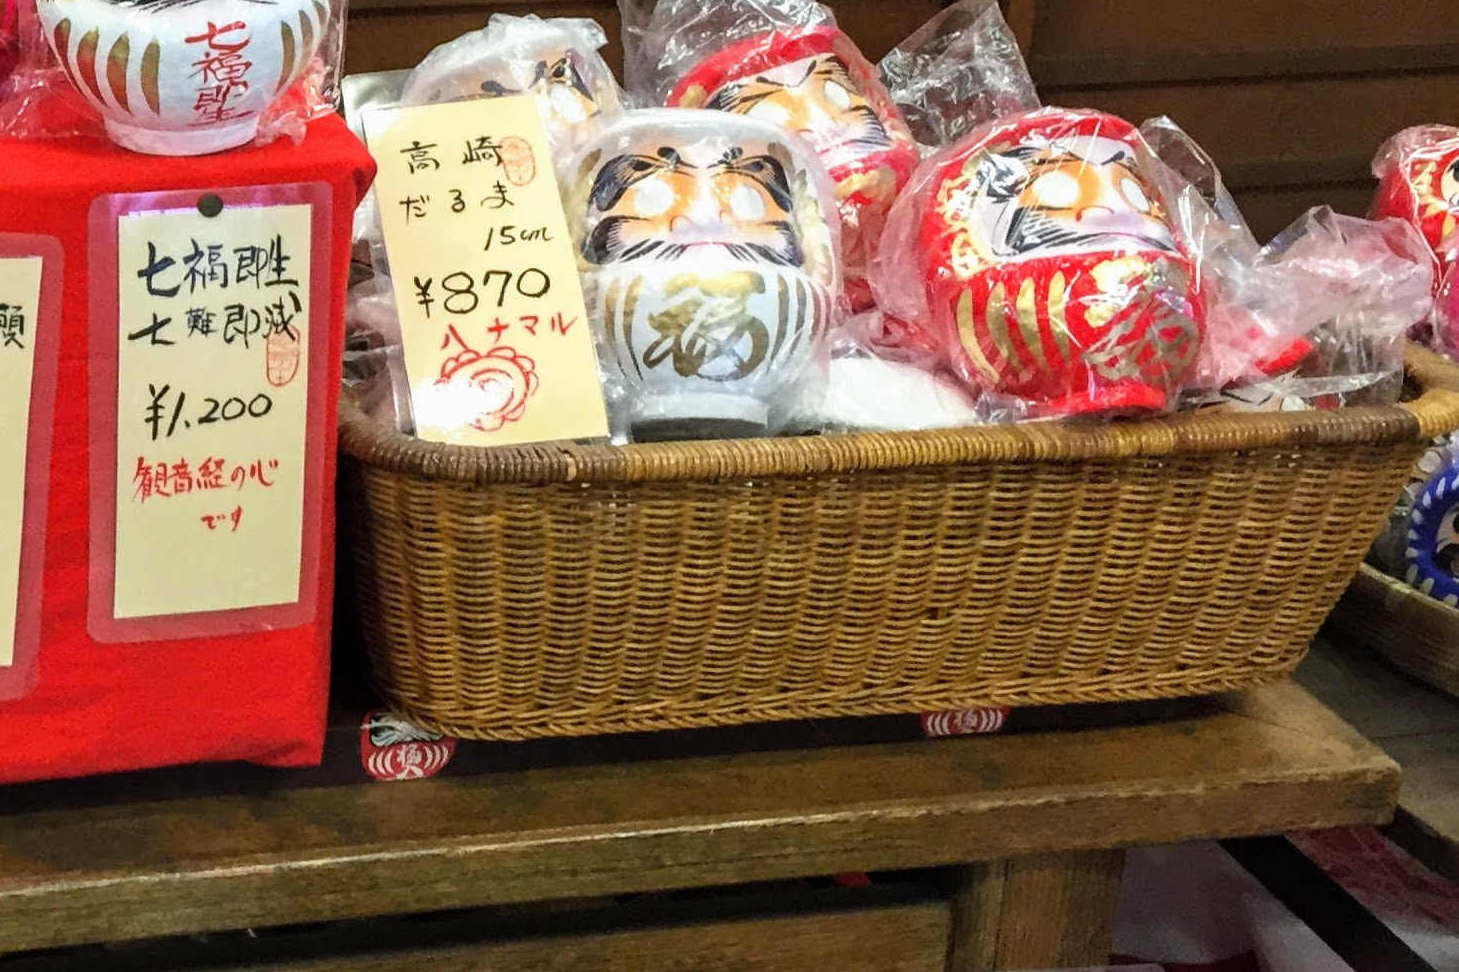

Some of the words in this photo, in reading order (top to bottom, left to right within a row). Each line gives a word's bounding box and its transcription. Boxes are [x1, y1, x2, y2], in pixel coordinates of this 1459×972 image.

[399, 179, 515, 227] だるま
[137, 233, 300, 299] 七福即生
[413, 267, 552, 320] ¥870
[440, 311, 580, 352] ハナマル
[200, 506, 243, 533] です
